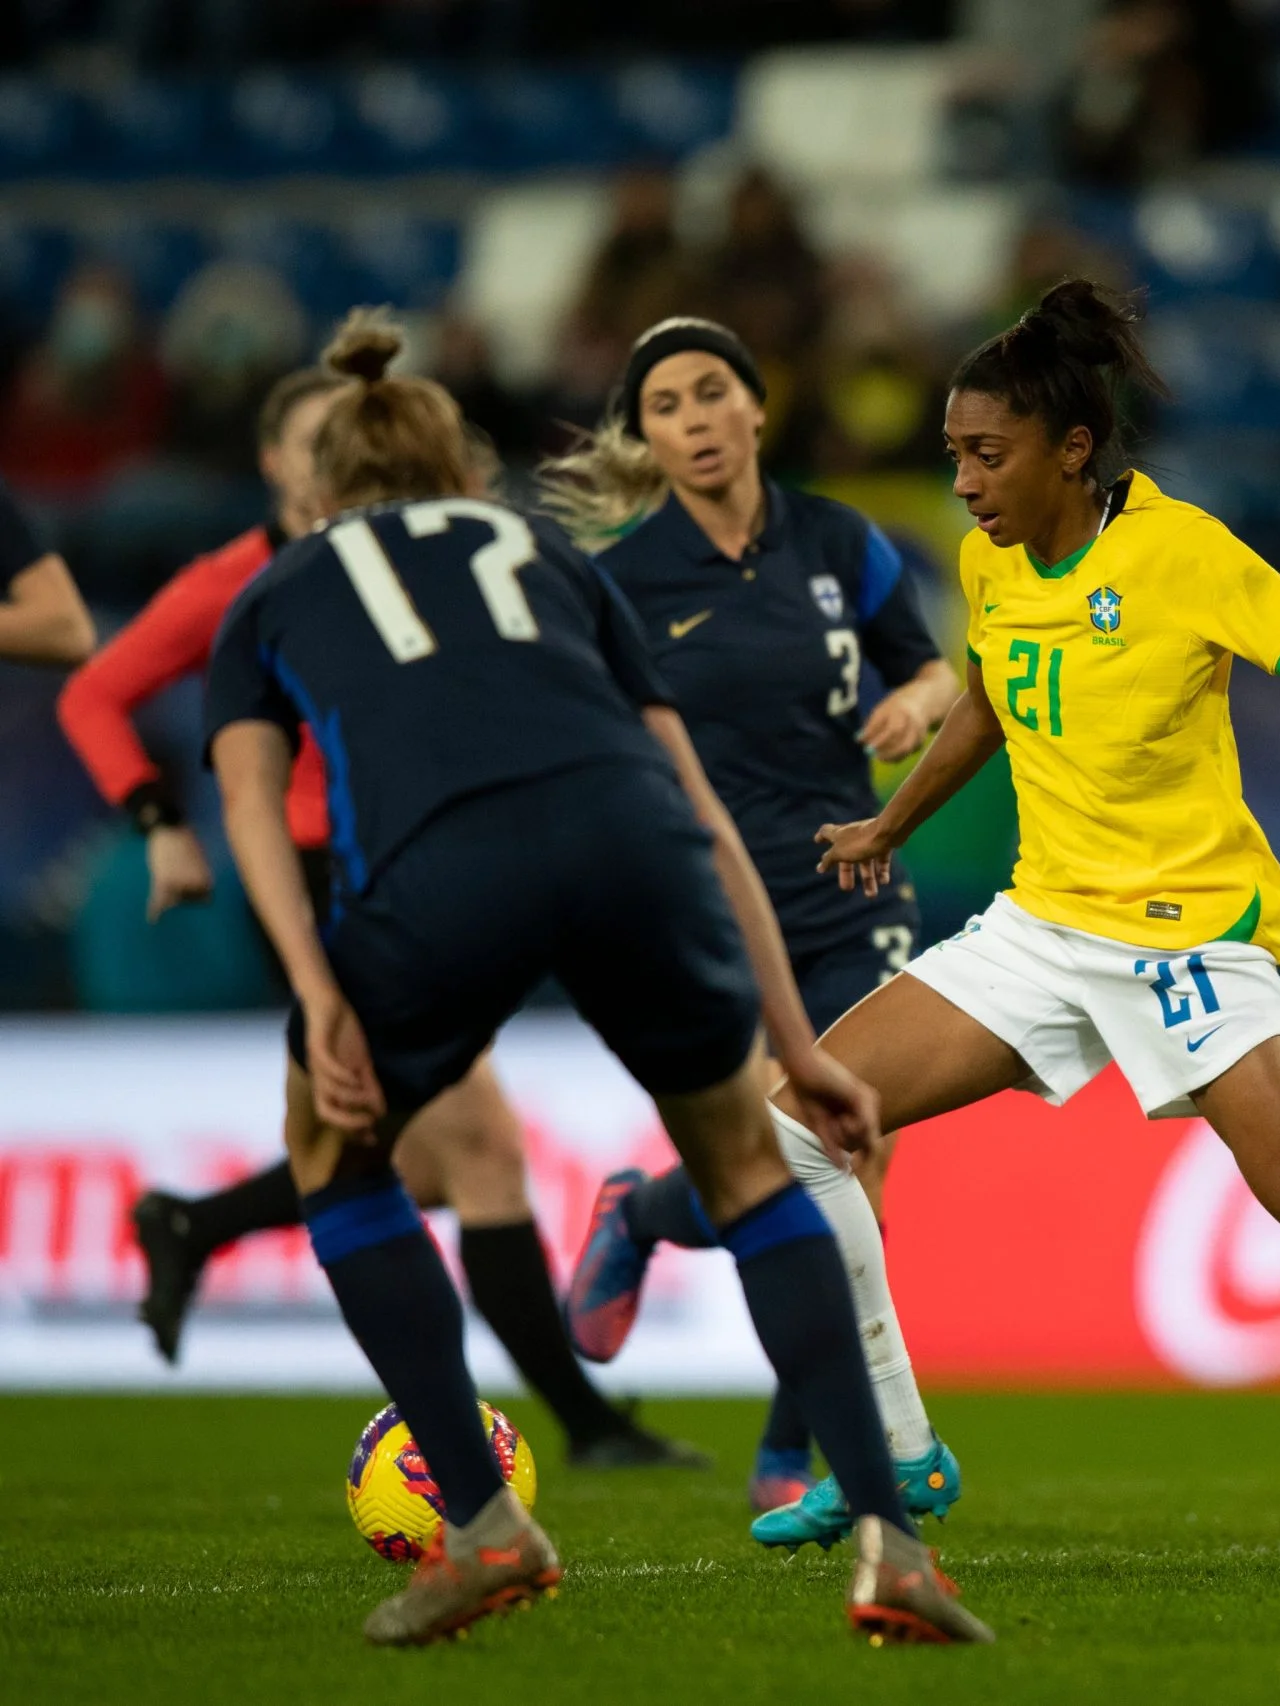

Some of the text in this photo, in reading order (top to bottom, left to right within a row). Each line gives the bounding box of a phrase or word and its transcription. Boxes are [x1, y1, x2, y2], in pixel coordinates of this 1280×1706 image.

[327, 498, 539, 665] 17
[1098, 605, 1112, 613] CBF
[824, 628, 861, 717] 3
[1092, 635, 1127, 647] BRASIL
[1006, 637, 1064, 737] 21
[1134, 952, 1221, 1029] 21
